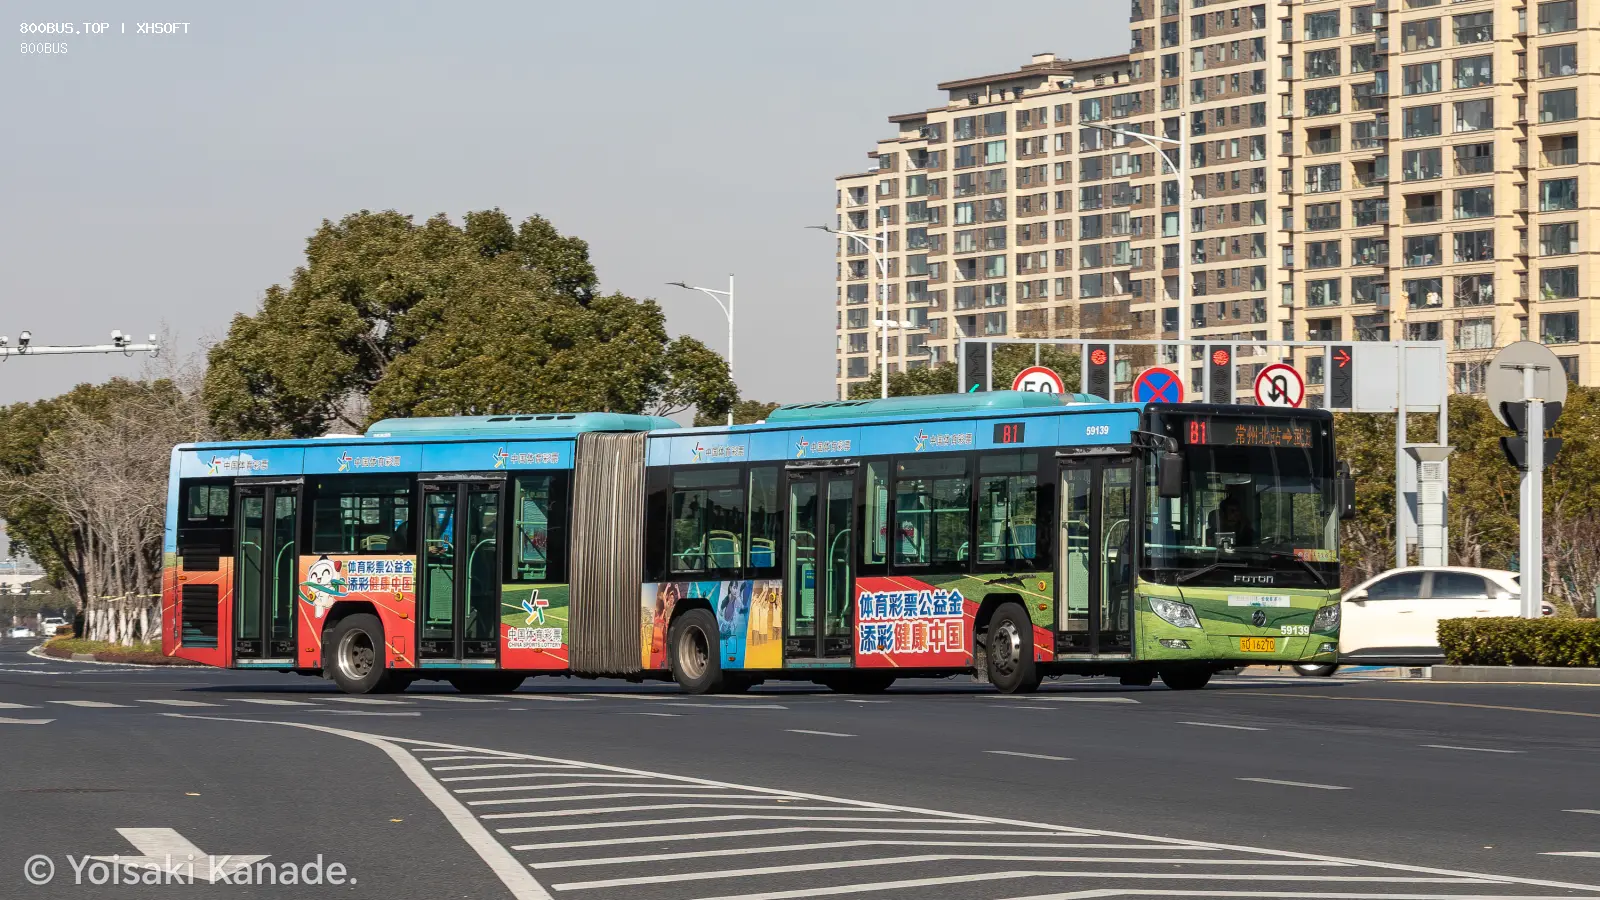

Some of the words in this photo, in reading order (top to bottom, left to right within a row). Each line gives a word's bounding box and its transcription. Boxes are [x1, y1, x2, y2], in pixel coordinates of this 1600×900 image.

[1086, 425, 1109, 436] 59139
[1188, 421, 1206, 445] B1
[928, 433, 972, 446] 中国体育彩票
[705, 446, 745, 457] 中国体育彩票
[810, 440, 851, 453] 中国体育彩票
[353, 456, 401, 468] 中国体育彩票
[511, 452, 559, 464] 中国体育彩票
[223, 459, 269, 471] 中国体育彩票
[347, 560, 413, 574] 体育彩票公益金
[347, 576, 413, 592] 添彩健康中国
[1233, 575, 1274, 583] FOTON
[859, 590, 963, 618] 体育彩票公益金
[508, 628, 562, 641] 中国体育彩票
[859, 621, 964, 652] 添彩健康中国
[1280, 625, 1310, 635] 59139
